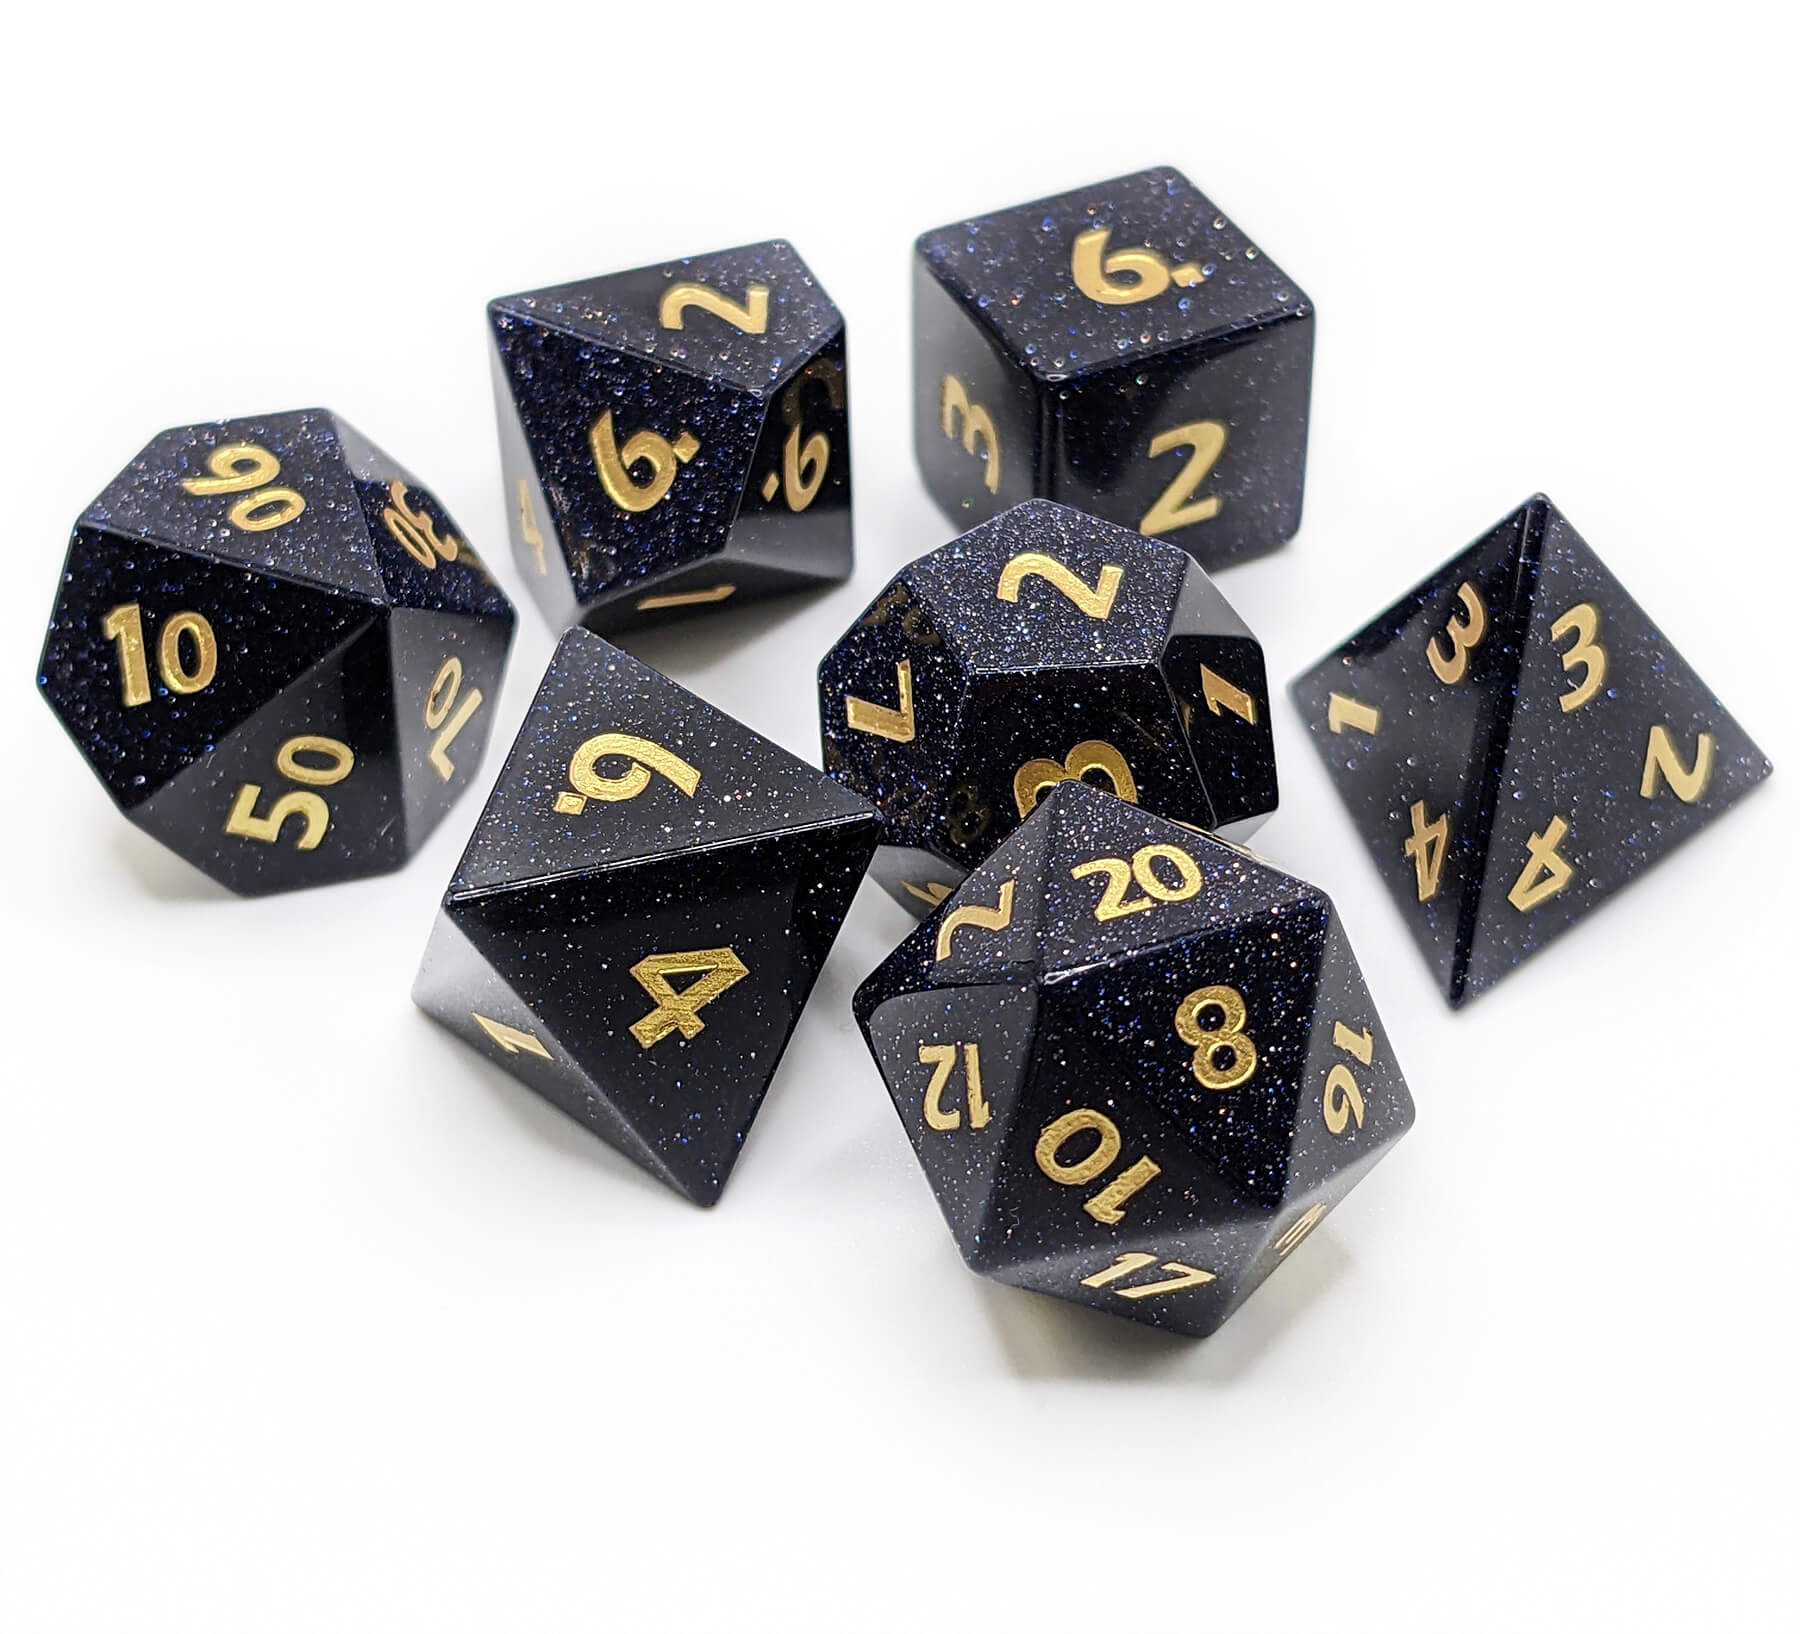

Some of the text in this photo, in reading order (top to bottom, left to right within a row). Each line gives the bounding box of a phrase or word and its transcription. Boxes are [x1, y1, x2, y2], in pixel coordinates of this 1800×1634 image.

[660, 282, 768, 334] 2
[941, 375, 999, 494] 3
[1139, 421, 1226, 536] 2
[182, 443, 306, 532] 90
[383, 480, 459, 569] 30
[996, 551, 1123, 620] 2
[103, 603, 218, 708] 10
[1425, 582, 1486, 684] 3
[1550, 602, 1607, 713] 3
[1200, 663, 1257, 726] 1
[1328, 692, 1380, 735] 1
[225, 734, 355, 851] 50
[1640, 725, 1714, 803] 2
[1070, 842, 1204, 923] 20
[1405, 800, 1449, 902] 4
[1507, 814, 1575, 912] 4
[935, 879, 1016, 962] 2
[472, 1013, 554, 1061] 1
[628, 947, 750, 1049] 4
[1174, 984, 1258, 1091] 8
[917, 1042, 993, 1132] 12
[1322, 1021, 1376, 1135] 16
[1033, 1108, 1163, 1226] 10
[1081, 1251, 1217, 1300] 17
